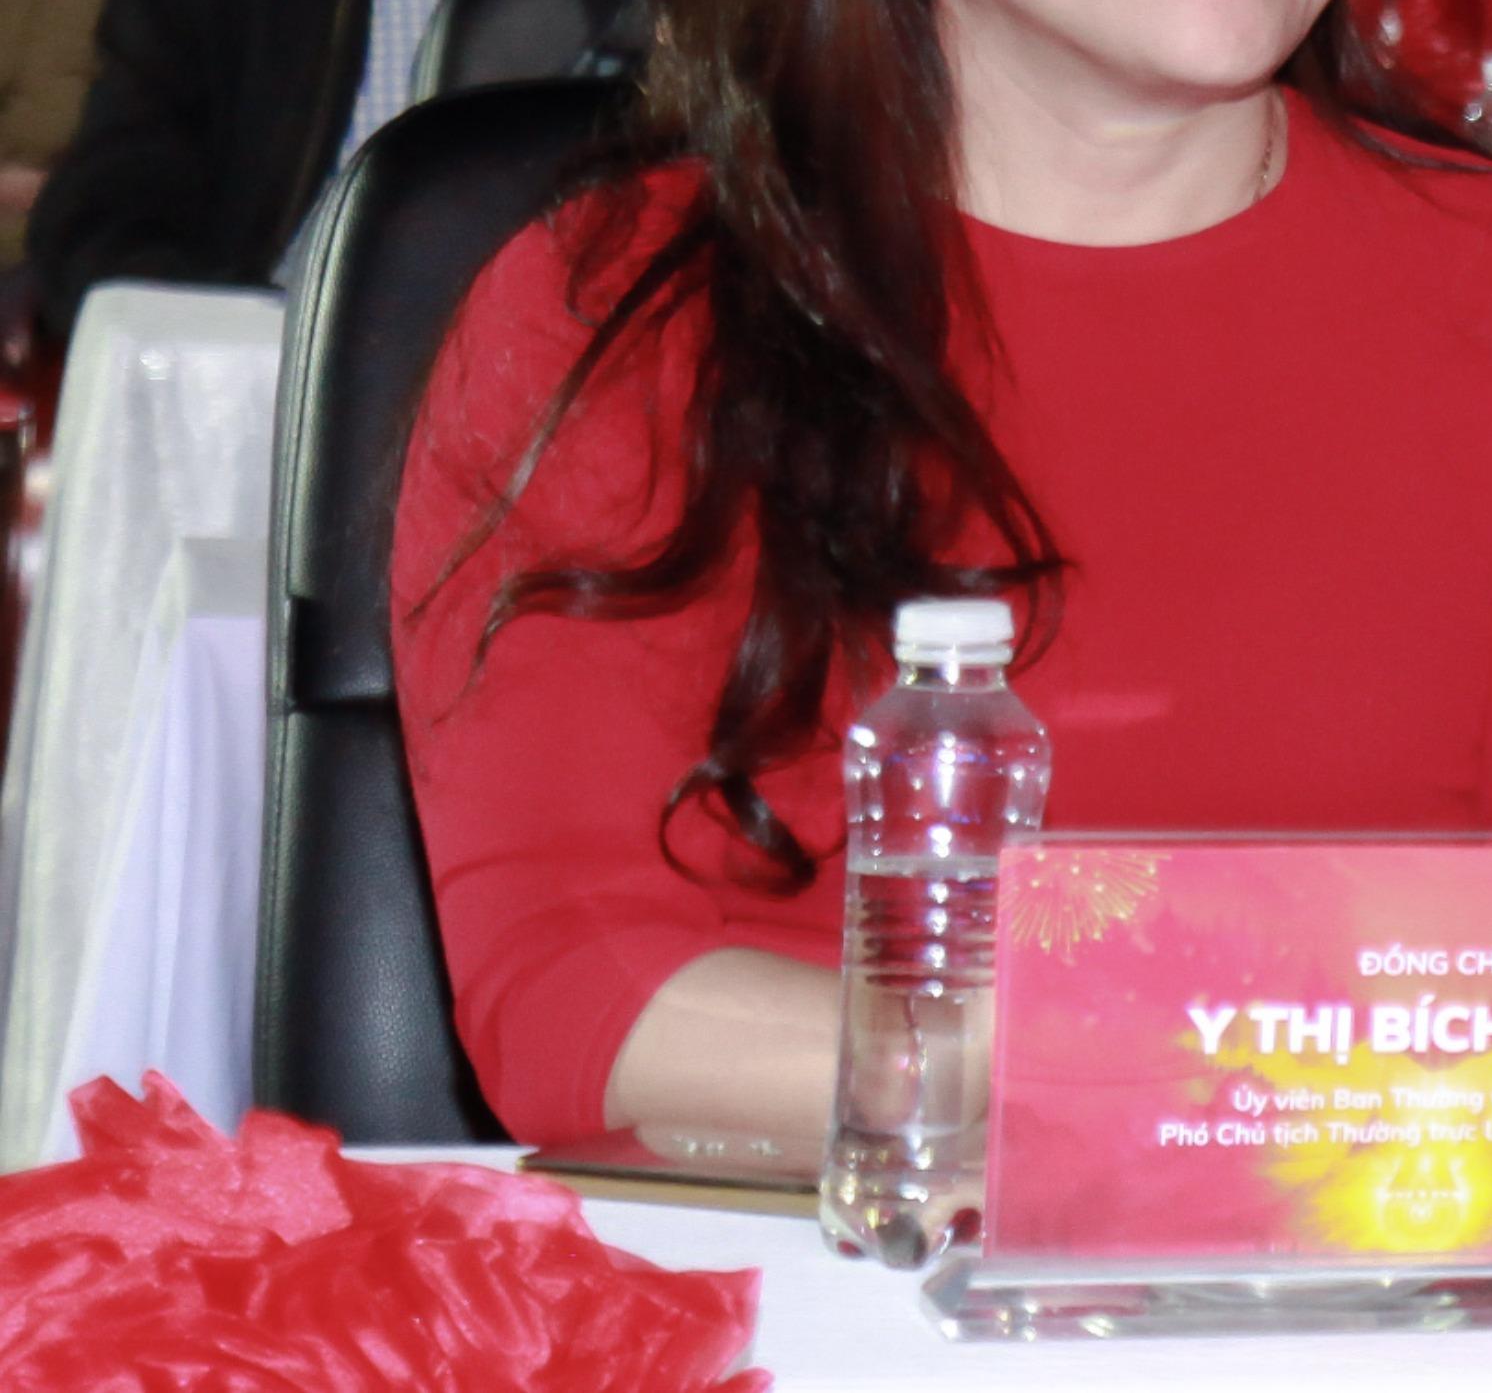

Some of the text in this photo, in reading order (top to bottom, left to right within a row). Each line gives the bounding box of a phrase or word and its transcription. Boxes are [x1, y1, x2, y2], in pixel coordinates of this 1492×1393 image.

[1187, 1003, 1237, 1055] Y
[1248, 1003, 1351, 1065] THỊ
[1333, 1088, 1383, 1110] Ban
[1159, 1121, 1209, 1147] Phó
